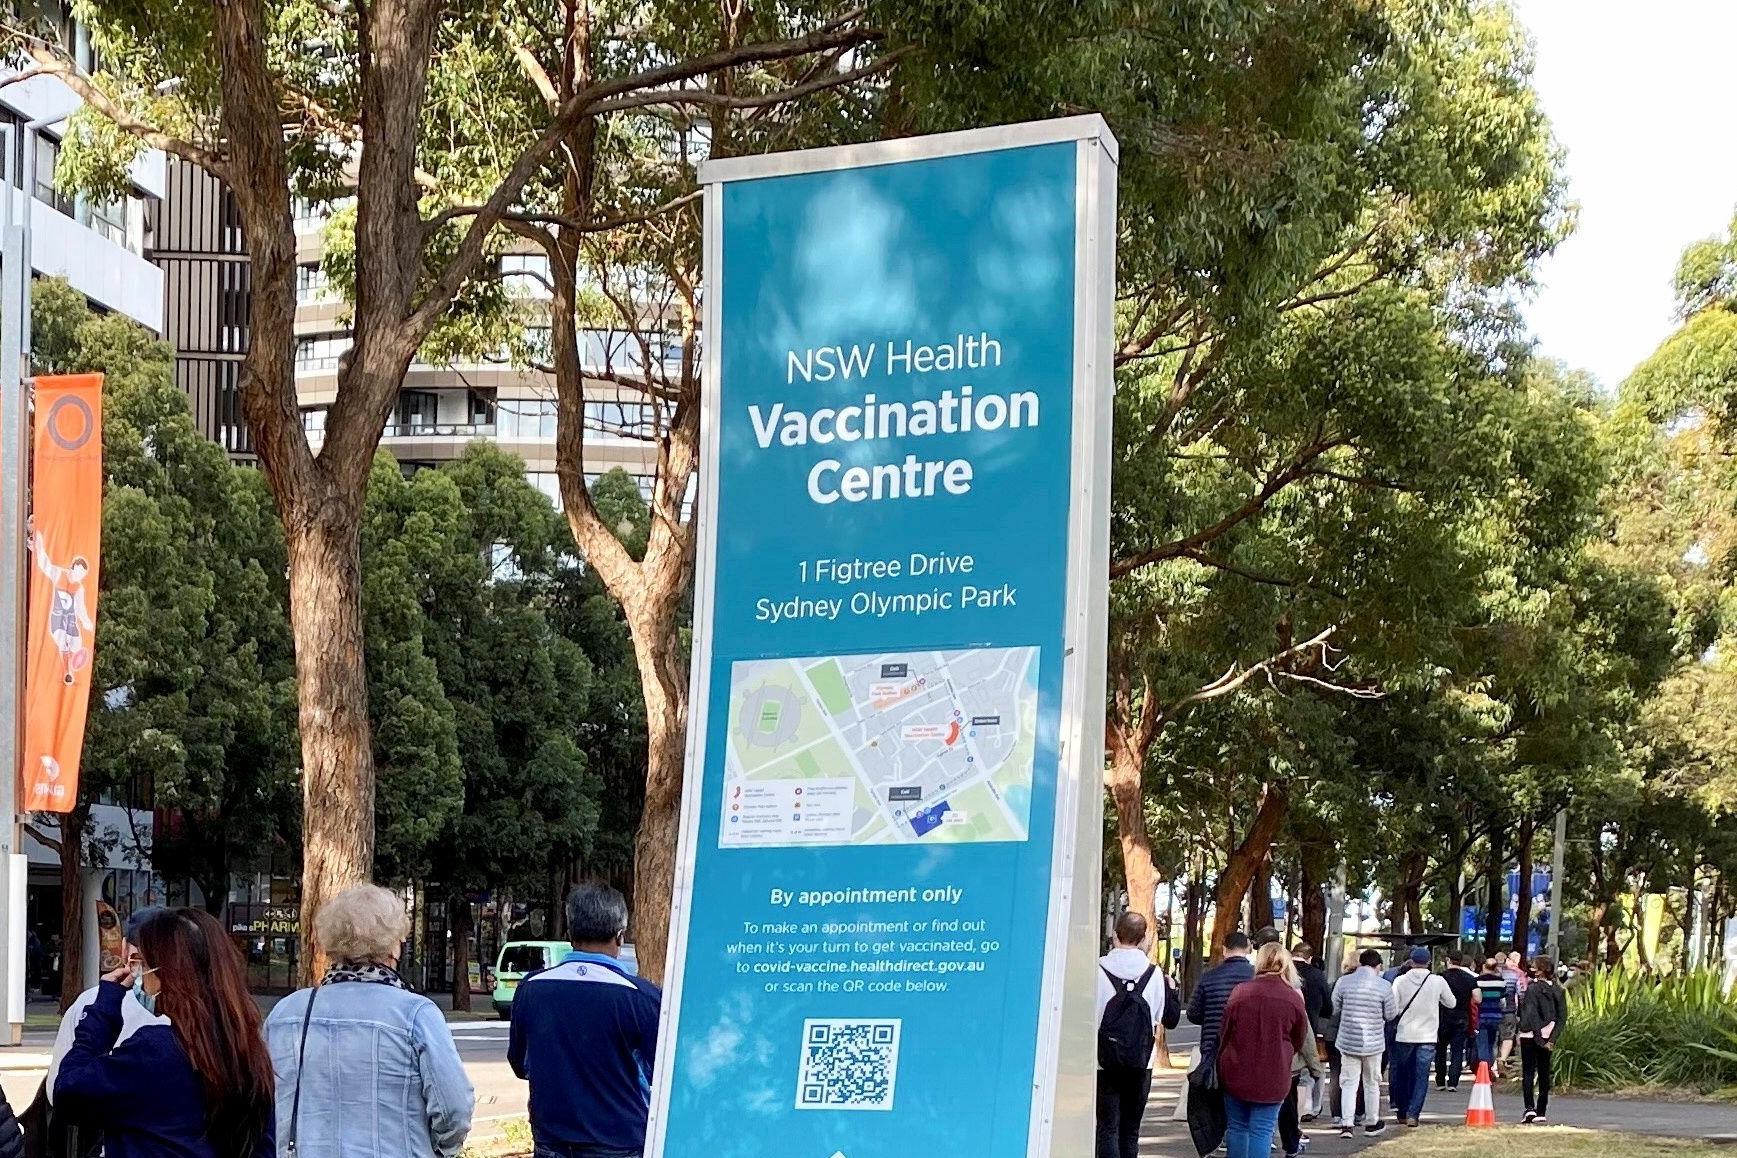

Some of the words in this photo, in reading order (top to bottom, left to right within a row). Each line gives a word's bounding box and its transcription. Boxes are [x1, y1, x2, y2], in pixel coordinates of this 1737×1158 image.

[788, 343, 875, 383] NSW
[888, 333, 1000, 374] Health
[748, 386, 1039, 449] Vaccination
[808, 455, 973, 504] Centre
[799, 561, 806, 583] 1
[816, 559, 901, 584] Figtree
[910, 552, 973, 575] Drive
[756, 596, 842, 623] Sydney
[851, 588, 952, 617] Olympic
[962, 584, 1016, 608] Park
[771, 889, 793, 907] By
[799, 887, 917, 906] appointment
[922, 886, 962, 904] only
[253, 920, 301, 933] PHARM
[744, 922, 758, 934] To
[762, 921, 797, 934] make
[801, 923, 817, 933] an
[822, 920, 908, 935] appointment
[912, 921, 928, 931] or
[931, 919, 958, 931] find
[962, 919, 985, 931] out
[727, 942, 762, 955] when
[788, 942, 819, 956] your
[823, 942, 850, 952] turn
[855, 941, 868, 952] to
[872, 941, 895, 954] get
[899, 939, 976, 952] vaccinated,
[981, 941, 999, 953] go
[737, 962, 750, 973] to
[753, 960, 984, 974] covid-vaccine.healthdirect.gov.au
[765, 981, 779, 992] or
[782, 982, 813, 992] scan
[817, 980, 839, 992] the
[843, 980, 864, 992] QR
[868, 980, 901, 992] code
